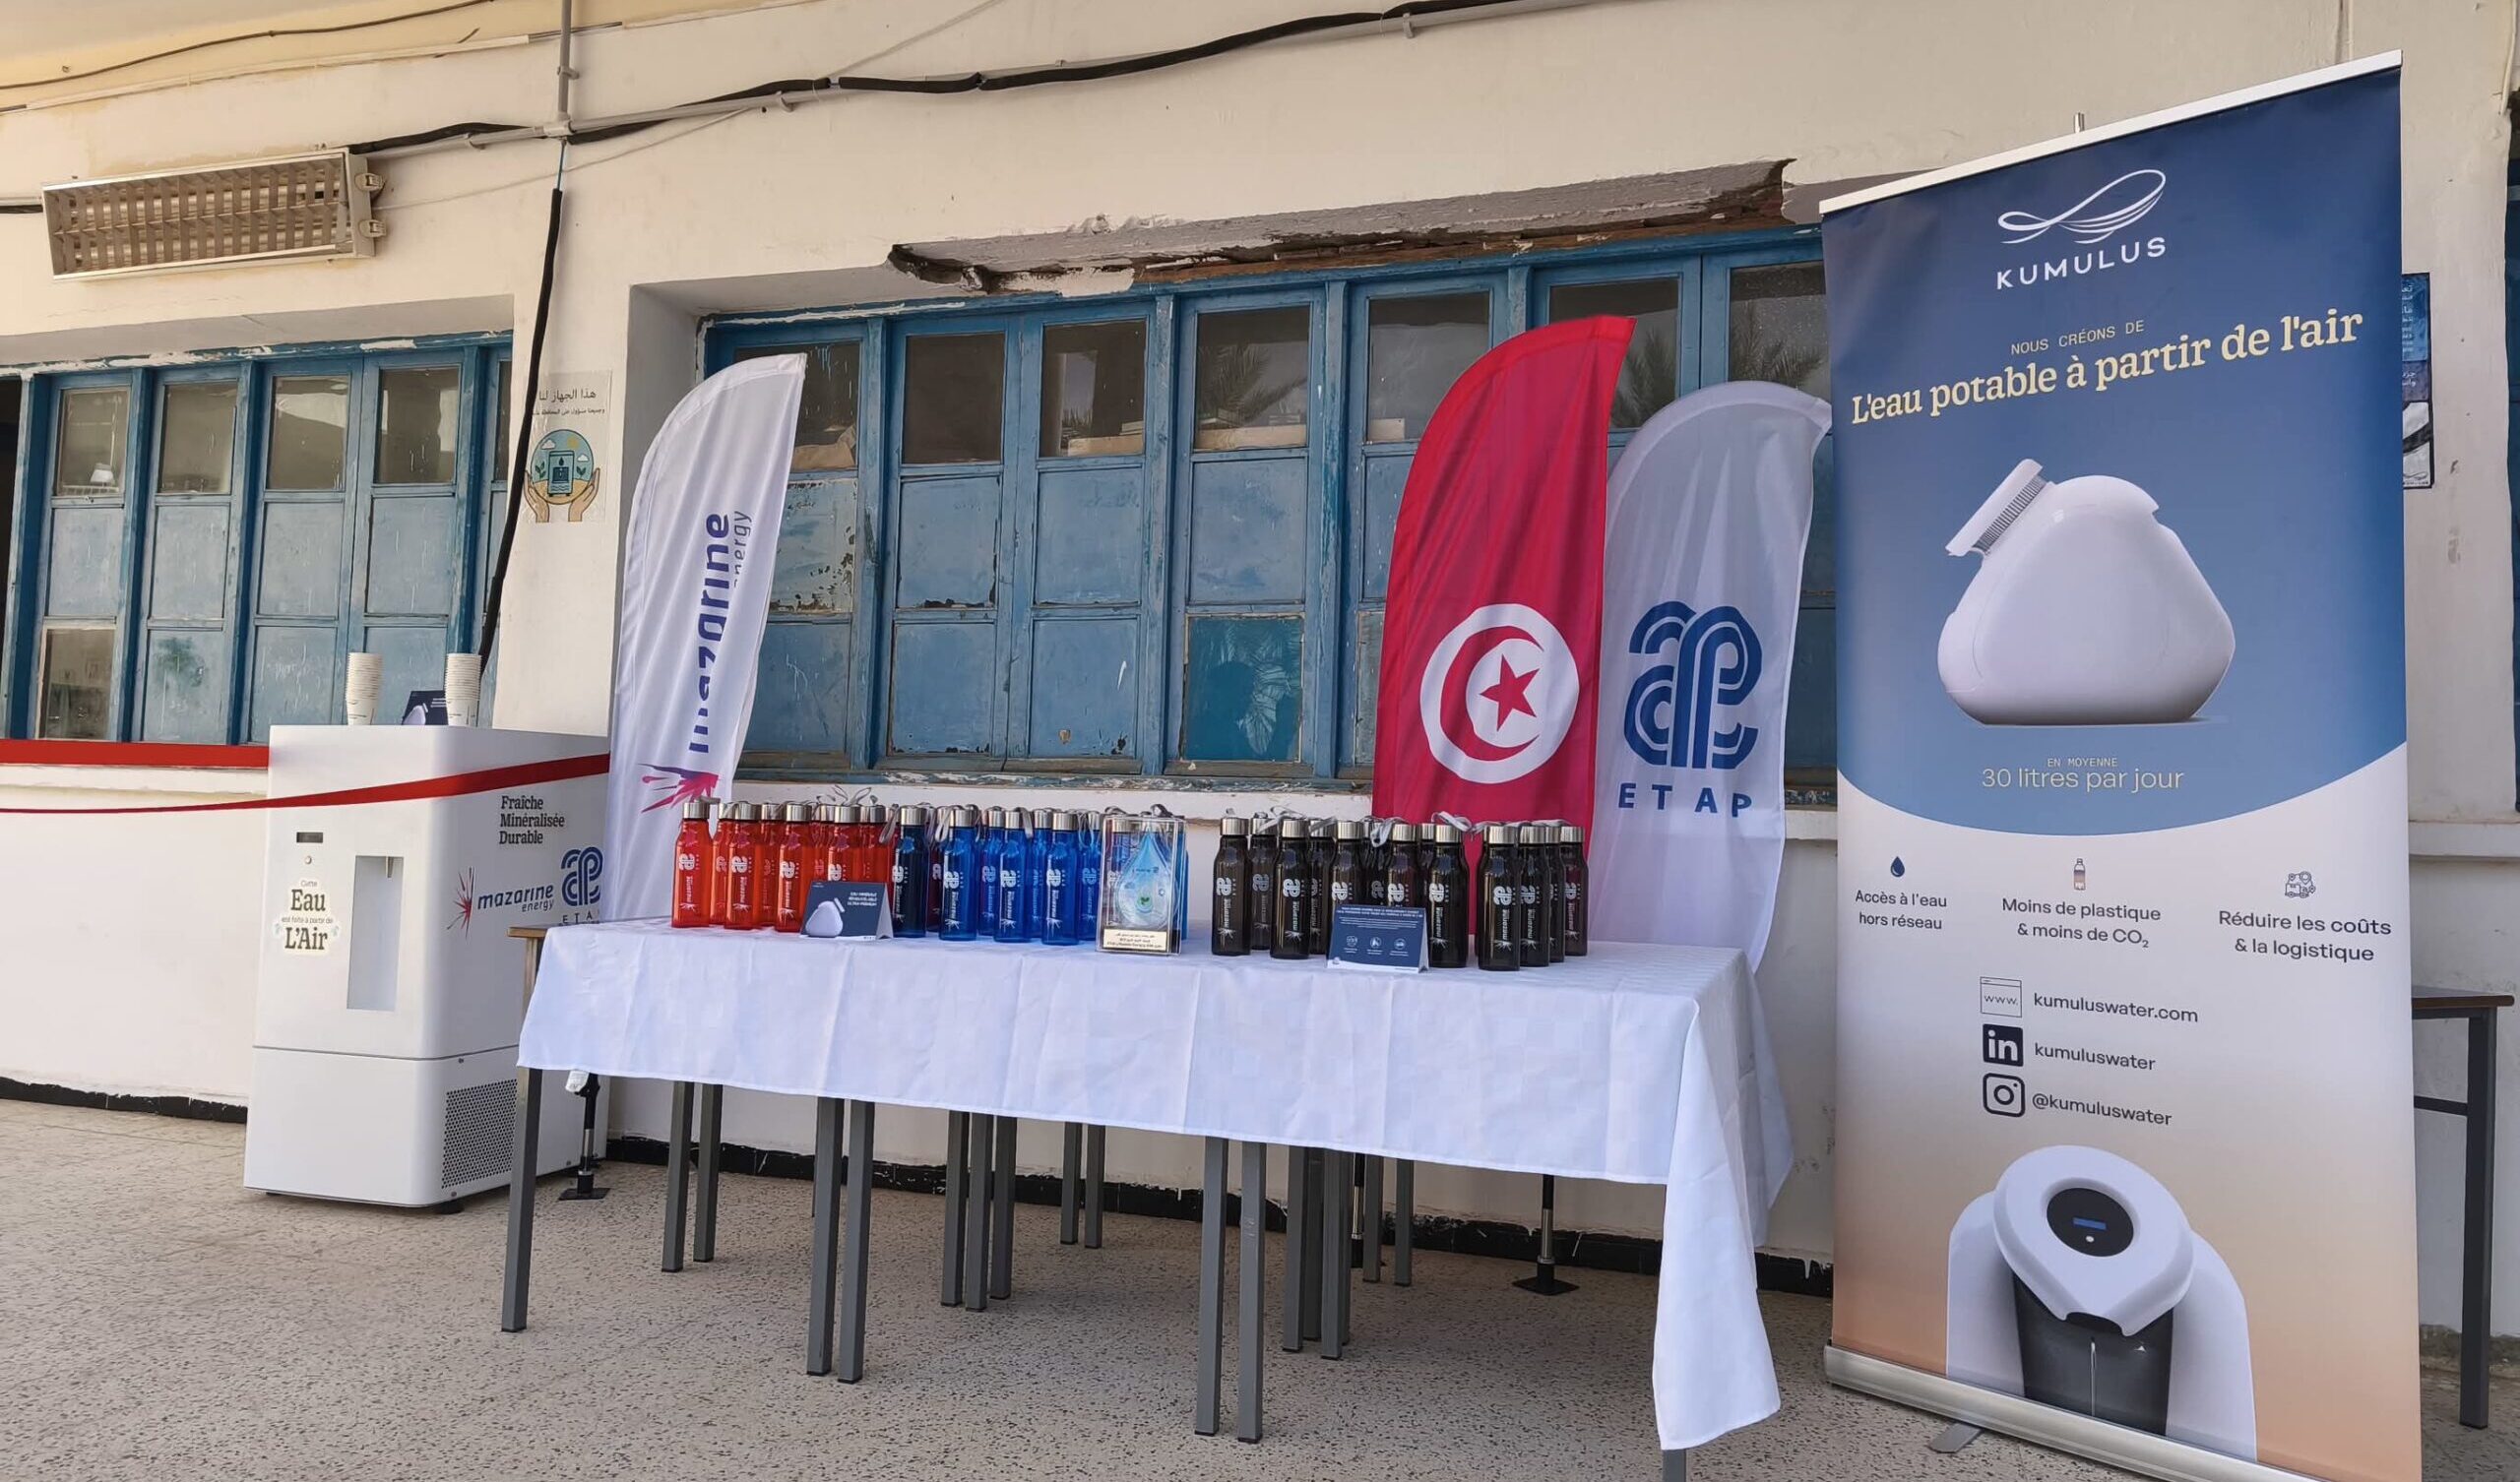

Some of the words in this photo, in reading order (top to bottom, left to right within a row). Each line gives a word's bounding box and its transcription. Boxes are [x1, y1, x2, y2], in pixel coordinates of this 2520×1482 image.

[1996, 237, 2166, 289] KUMULUS
[2010, 339, 2048, 355] NOUS
[2058, 326, 2115, 347] CRÉONS
[2125, 320, 2144, 334] DE
[1852, 389, 1922, 424] L'eau
[1929, 362, 2057, 416] potable
[2066, 355, 2087, 388] à
[2095, 334, 2211, 391] partir
[2221, 324, 2270, 361] de
[2280, 308, 2362, 351] l'air
[580, 388, 597, 400] هذا
[733, 511, 752, 585] nergy
[2047, 758, 2060, 768] EN
[2068, 757, 2117, 768] MOYENNE
[1983, 769, 2011, 788] 30
[2018, 768, 2078, 788] litres
[2086, 772, 2127, 792] par
[2131, 769, 2184, 793] jour
[501, 795, 543, 810] Fraîche
[1618, 782, 1752, 817] ETAP
[500, 813, 565, 828] Minéralisée
[499, 831, 543, 844] Durable
[290, 889, 326, 911] Eau
[477, 885, 554, 909] mazarine
[522, 899, 554, 912] energy
[1855, 890, 1896, 905] Accès
[1899, 893, 1908, 905] à
[1912, 894, 1947, 907] l'eau
[562, 909, 598, 923] ETA
[1858, 911, 1888, 926] hors
[1891, 914, 1942, 929] réseau
[2002, 897, 2050, 914] Moins
[2055, 901, 2076, 915] de
[2080, 903, 2161, 922] plastique
[2017, 923, 2028, 936] &
[2033, 924, 2082, 940] moins
[2087, 927, 2109, 942] de
[2219, 910, 2292, 929] Réduire
[2297, 915, 2325, 931] les
[2331, 919, 2391, 935] coûts
[284, 927, 328, 950] L'Air
[2235, 938, 2247, 952] &
[2252, 939, 2267, 954] la
[2273, 940, 2374, 963] logistique
[2034, 993, 2198, 1022] kumuluswater.com
[2035, 1042, 2156, 1070] kumuluswater
[2032, 1093, 2173, 1125] @kumuluswater
